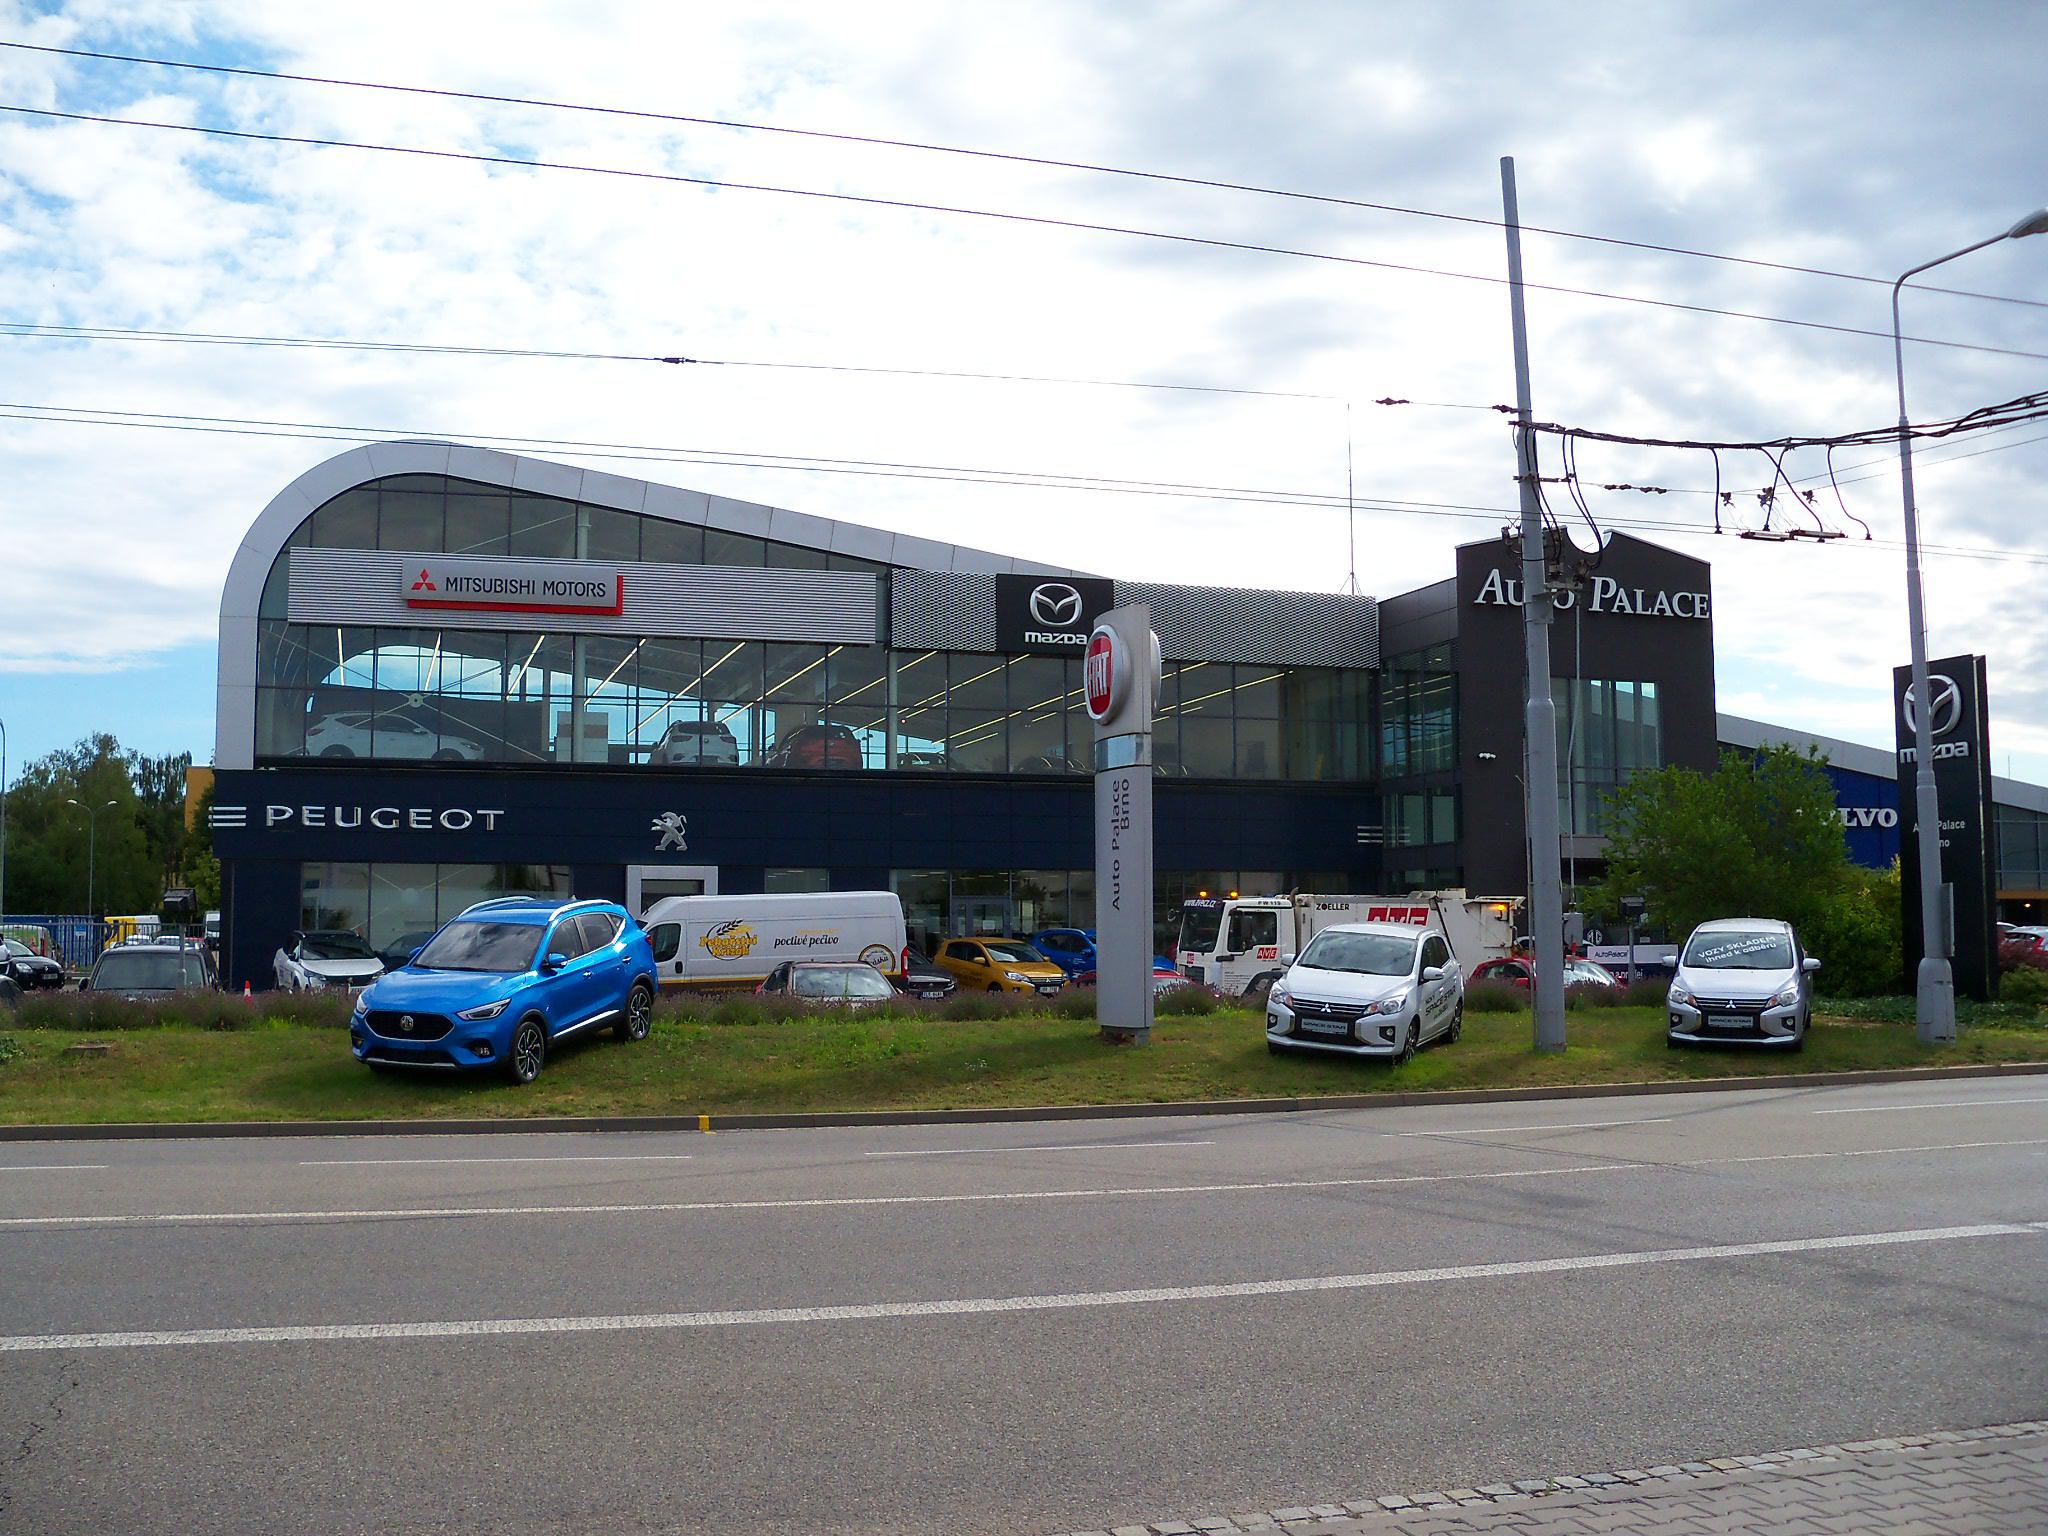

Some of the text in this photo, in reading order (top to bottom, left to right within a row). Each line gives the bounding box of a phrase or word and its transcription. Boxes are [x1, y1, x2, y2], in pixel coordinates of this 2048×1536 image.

[445, 577, 606, 597] MITSUBISHI MOTORS
[1474, 568, 1710, 619] AUO PALACE
[1087, 651, 1110, 699] FIAT
[1900, 741, 1969, 763] mzda
[1120, 778, 1130, 830] Brno
[266, 805, 505, 831] PEUGEOT
[1822, 807, 1898, 828] LVO
[1111, 779, 1120, 911] Auto Palace
[774, 934, 839, 949] poctivé pečivo
[1698, 936, 1776, 958] VOZY SKLADEM
[1742, 942, 1777, 954] odběru
[1257, 947, 1278, 960] AVE
